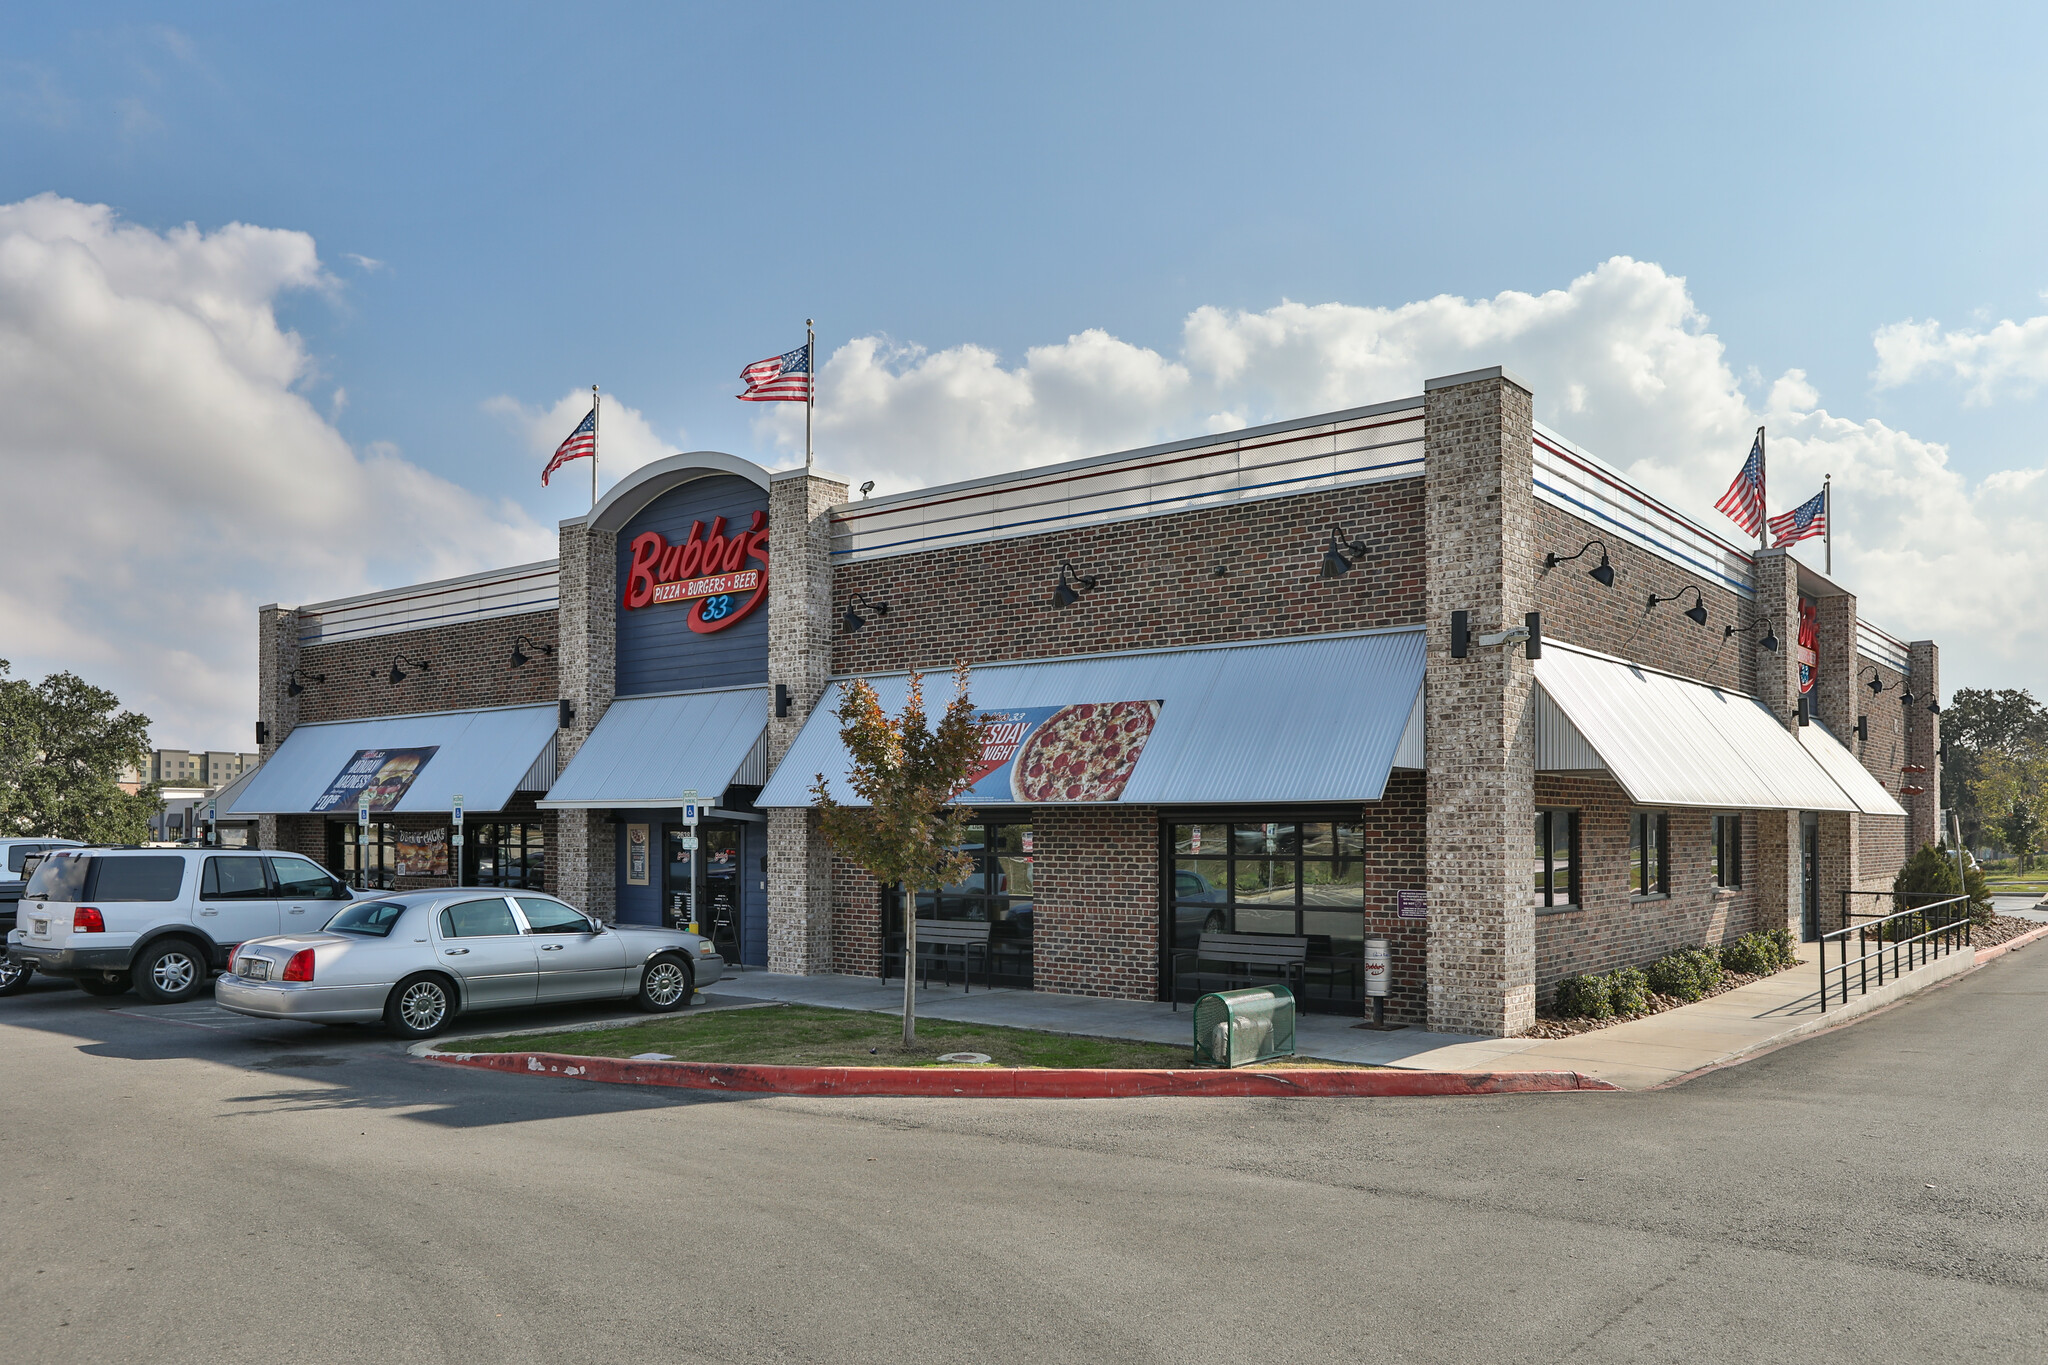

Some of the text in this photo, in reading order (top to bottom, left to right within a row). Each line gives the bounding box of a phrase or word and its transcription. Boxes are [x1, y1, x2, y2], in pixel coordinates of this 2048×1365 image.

[623, 510, 769, 613] Bubba's
[654, 571, 757, 601] PIZZA BURGERS BEER
[702, 594, 731, 621] 33
[1009, 712, 1026, 722] 33
[980, 744, 1020, 761] NIGHT
[347, 759, 382, 774] MONDAY
